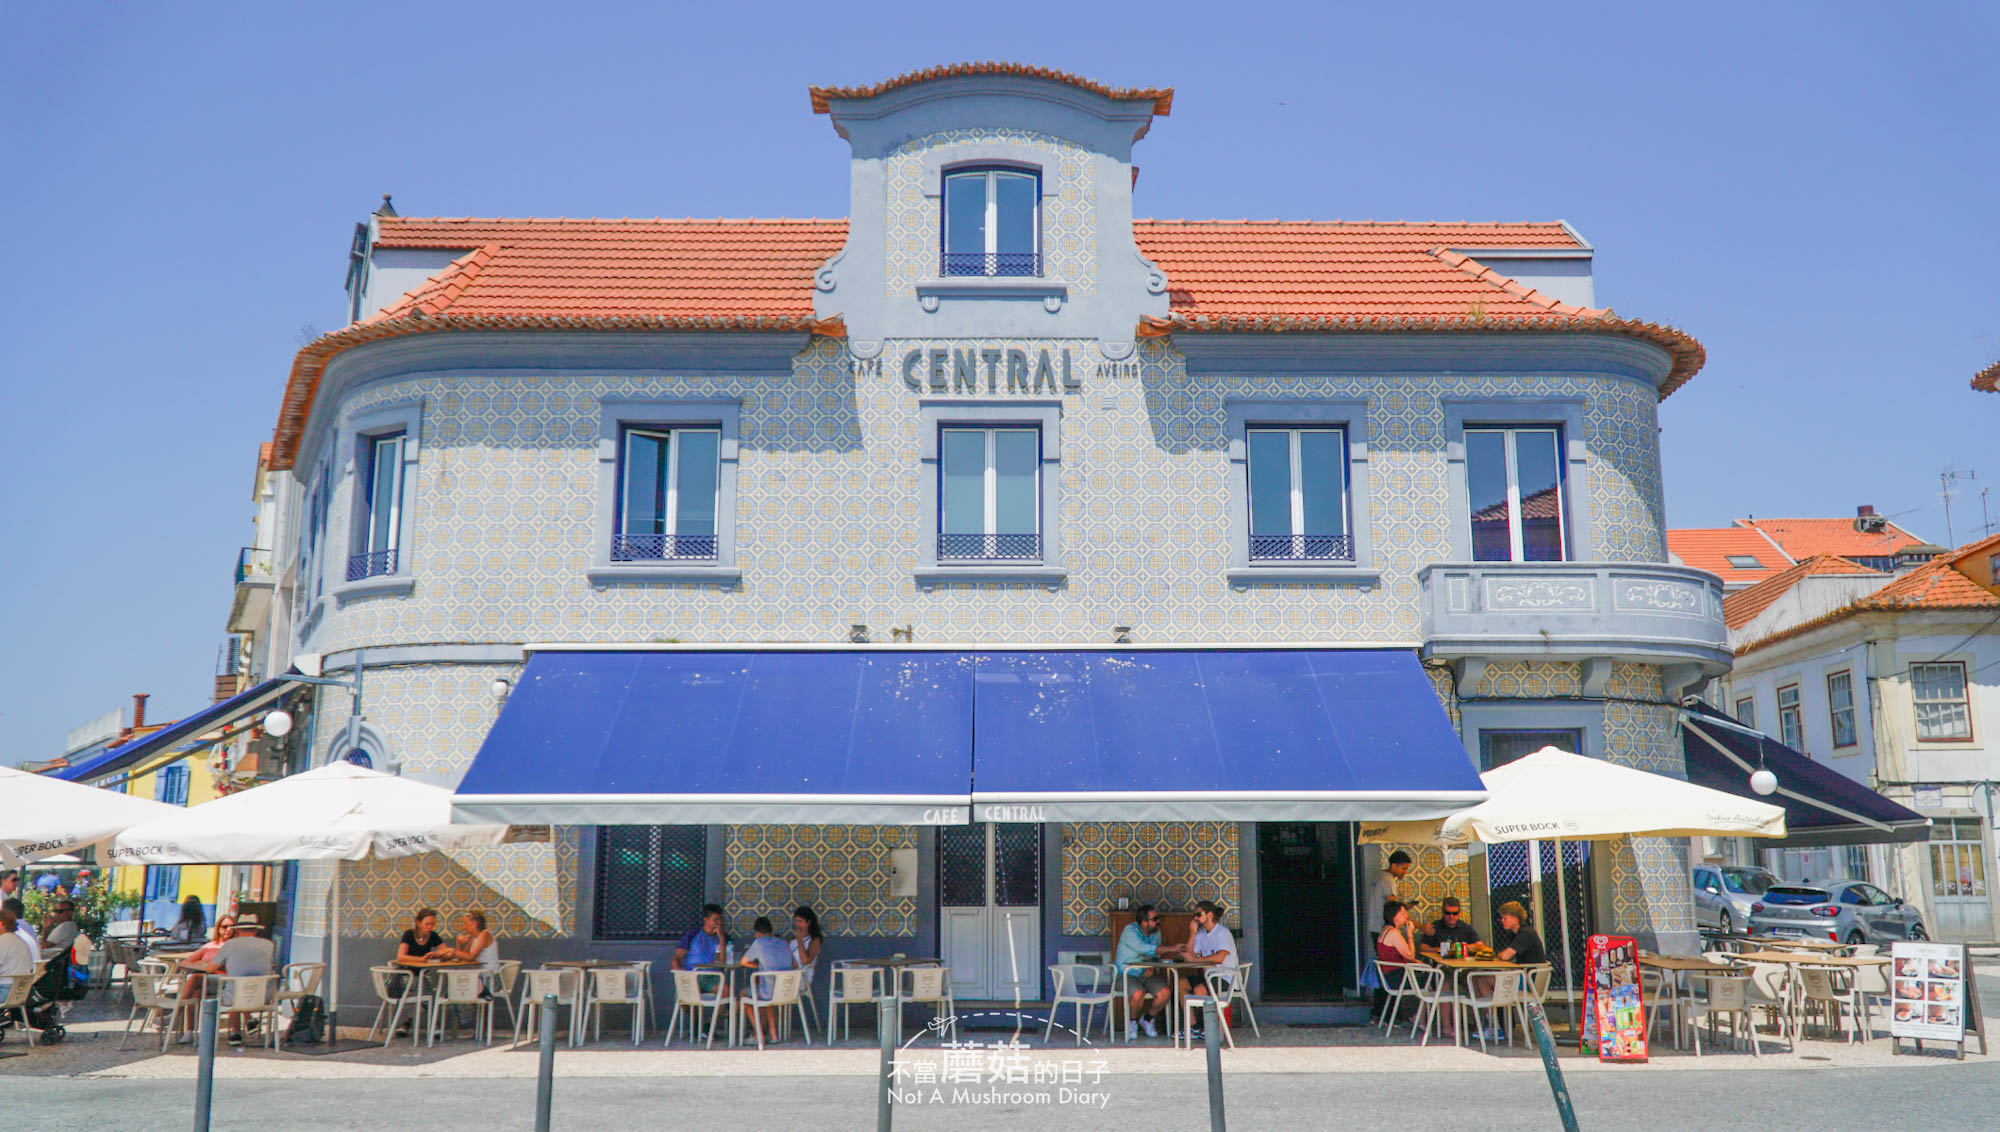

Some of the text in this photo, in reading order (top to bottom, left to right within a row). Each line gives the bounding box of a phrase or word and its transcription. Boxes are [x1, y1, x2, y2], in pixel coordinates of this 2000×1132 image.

[903, 348, 1082, 388] CENTRAL
[1096, 362, 1138, 378] AVEIRO
[923, 806, 959, 824] CAFÉ
[984, 806, 1046, 821] CENTRAL
[1494, 822, 1560, 835] SUPER BOCK
[37, 838, 63, 851] BOCK
[107, 845, 162, 859] SUPER BOCK
